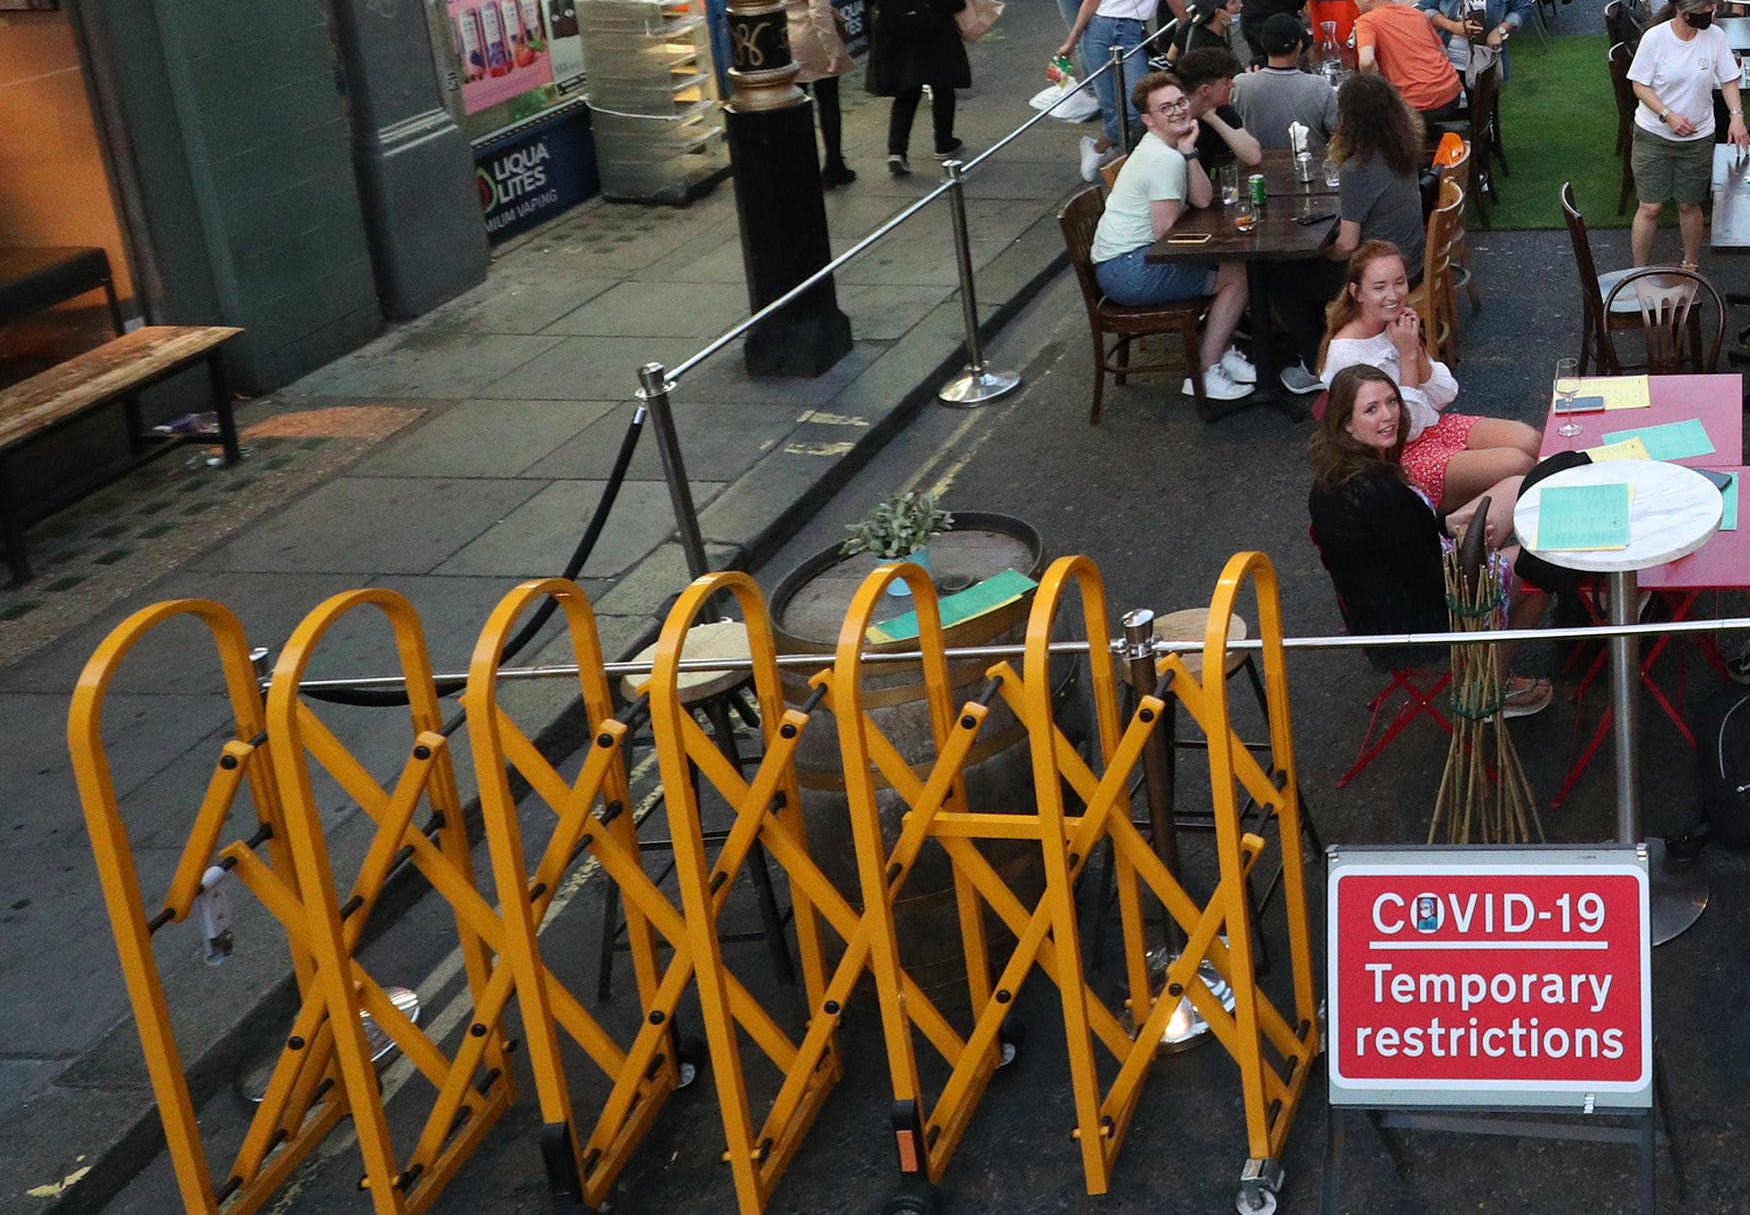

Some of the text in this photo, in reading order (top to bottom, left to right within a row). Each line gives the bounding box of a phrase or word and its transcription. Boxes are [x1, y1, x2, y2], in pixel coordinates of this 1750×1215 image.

[493, 142, 551, 181] LIQUA
[497, 166, 546, 204] LITES
[486, 188, 558, 232] MIUM VAPING
[1371, 892, 1606, 935] COVID-19
[1364, 963, 1613, 1013] Temporary
[1355, 1017, 1624, 1060] restrictions
